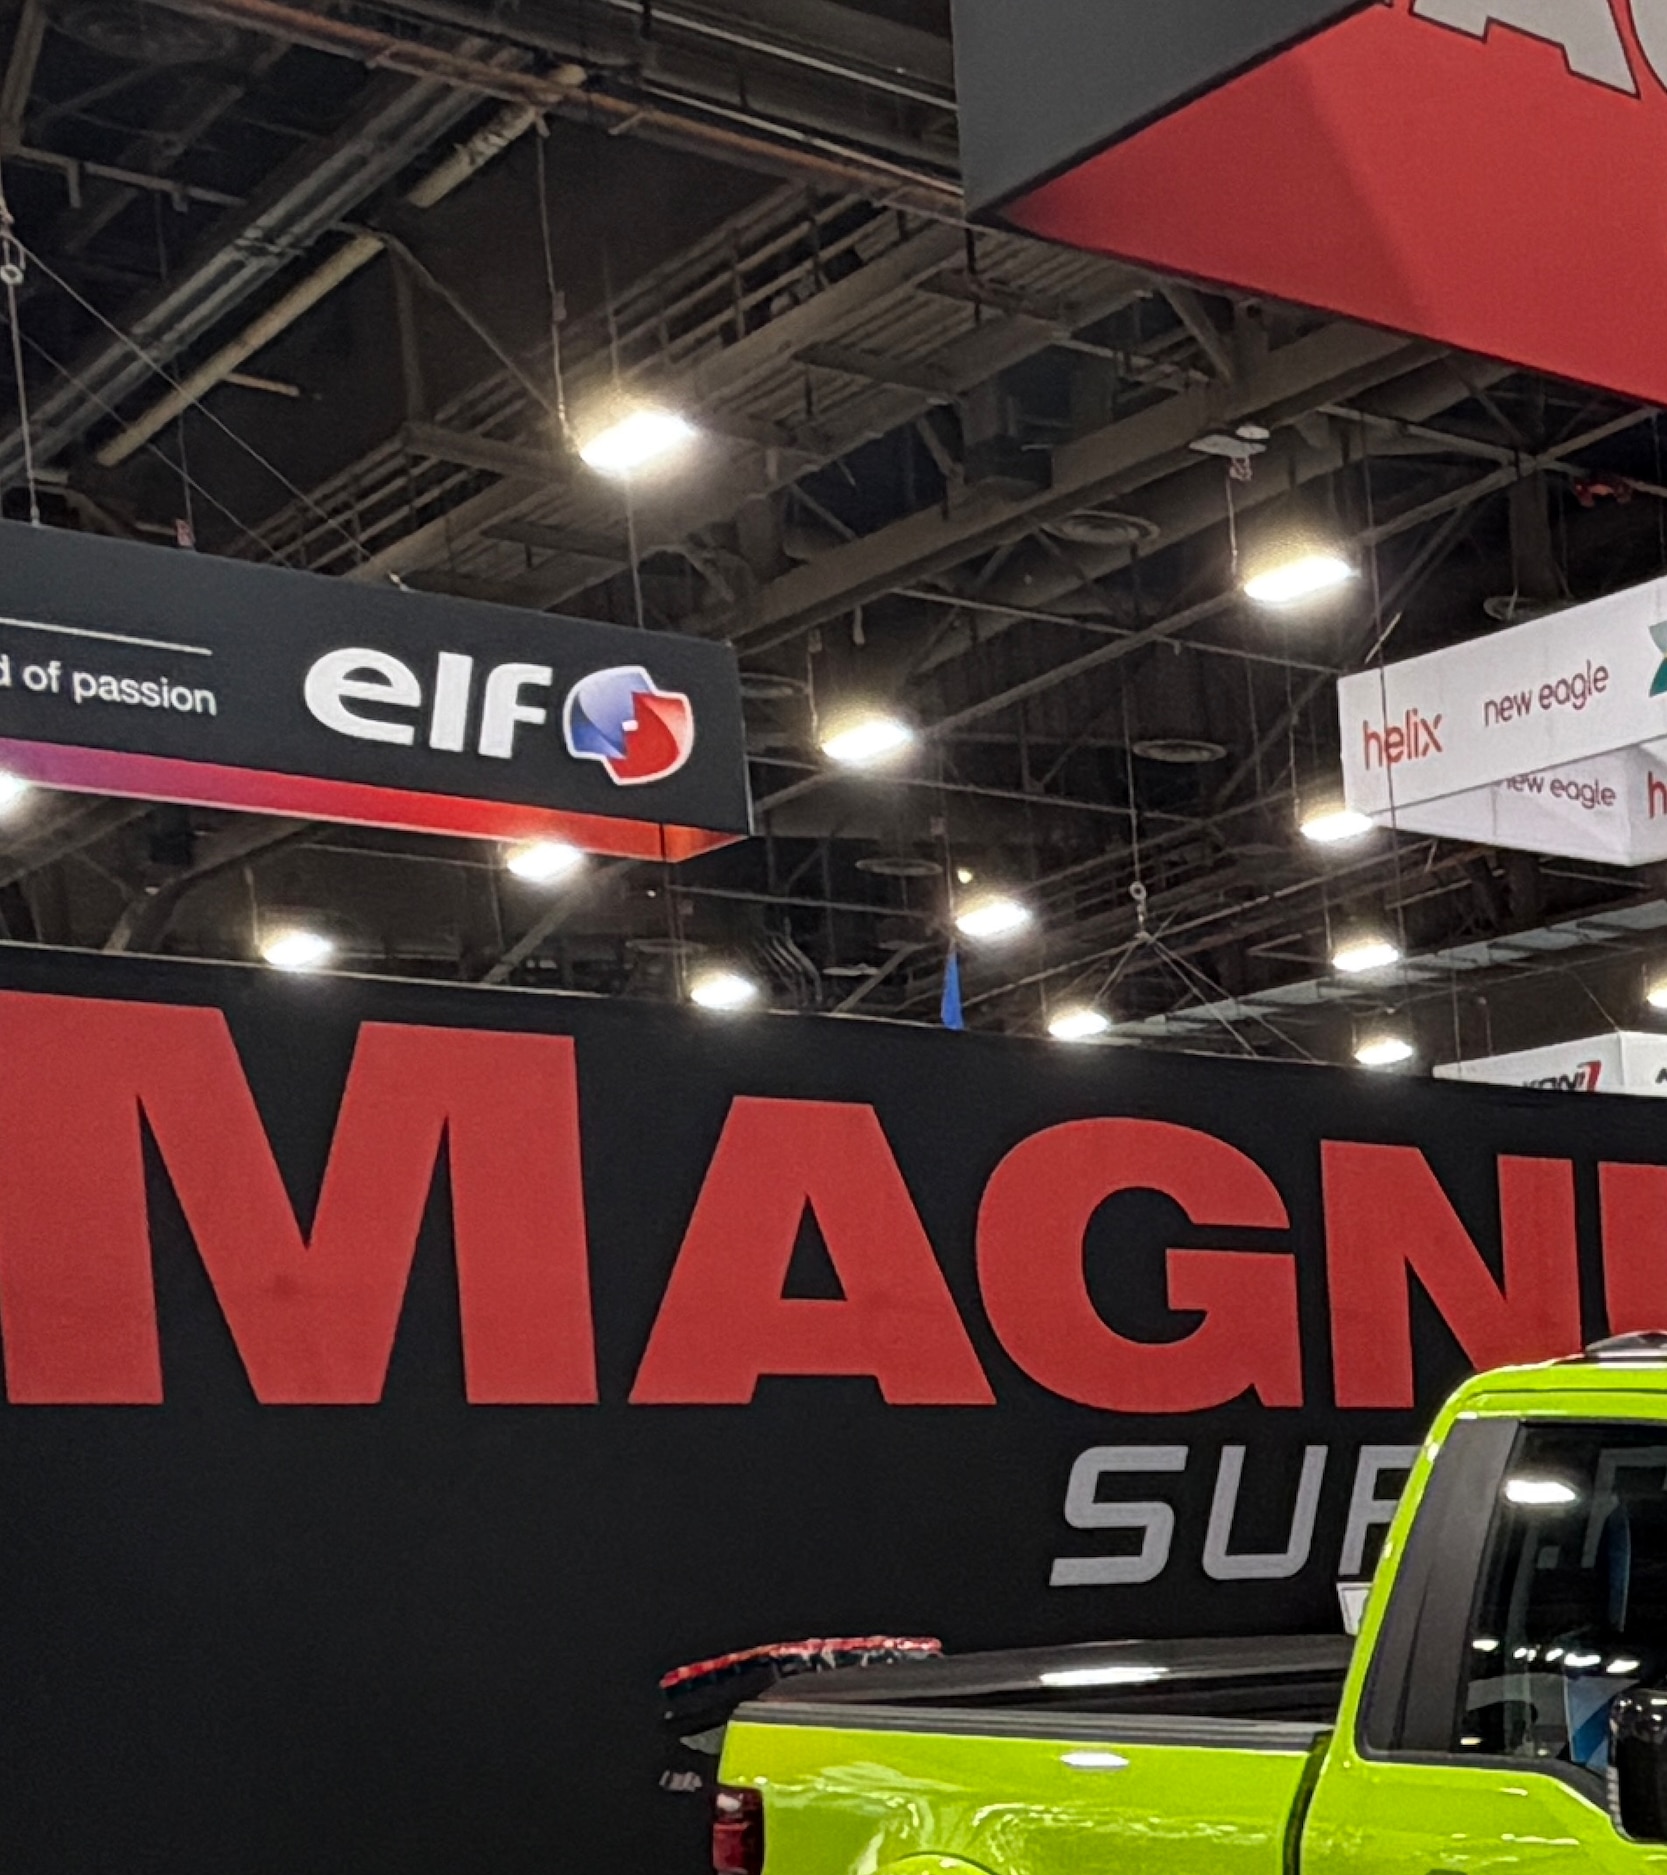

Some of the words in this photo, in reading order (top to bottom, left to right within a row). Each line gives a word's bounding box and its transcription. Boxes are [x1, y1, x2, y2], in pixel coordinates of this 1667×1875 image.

[23, 660, 62, 693] of
[72, 670, 217, 717] passion
[303, 647, 553, 760] elf
[1483, 687, 1533, 727] new
[1540, 660, 1610, 715] eagle
[1363, 709, 1442, 771] helix
[1550, 778, 1617, 809] eagle
